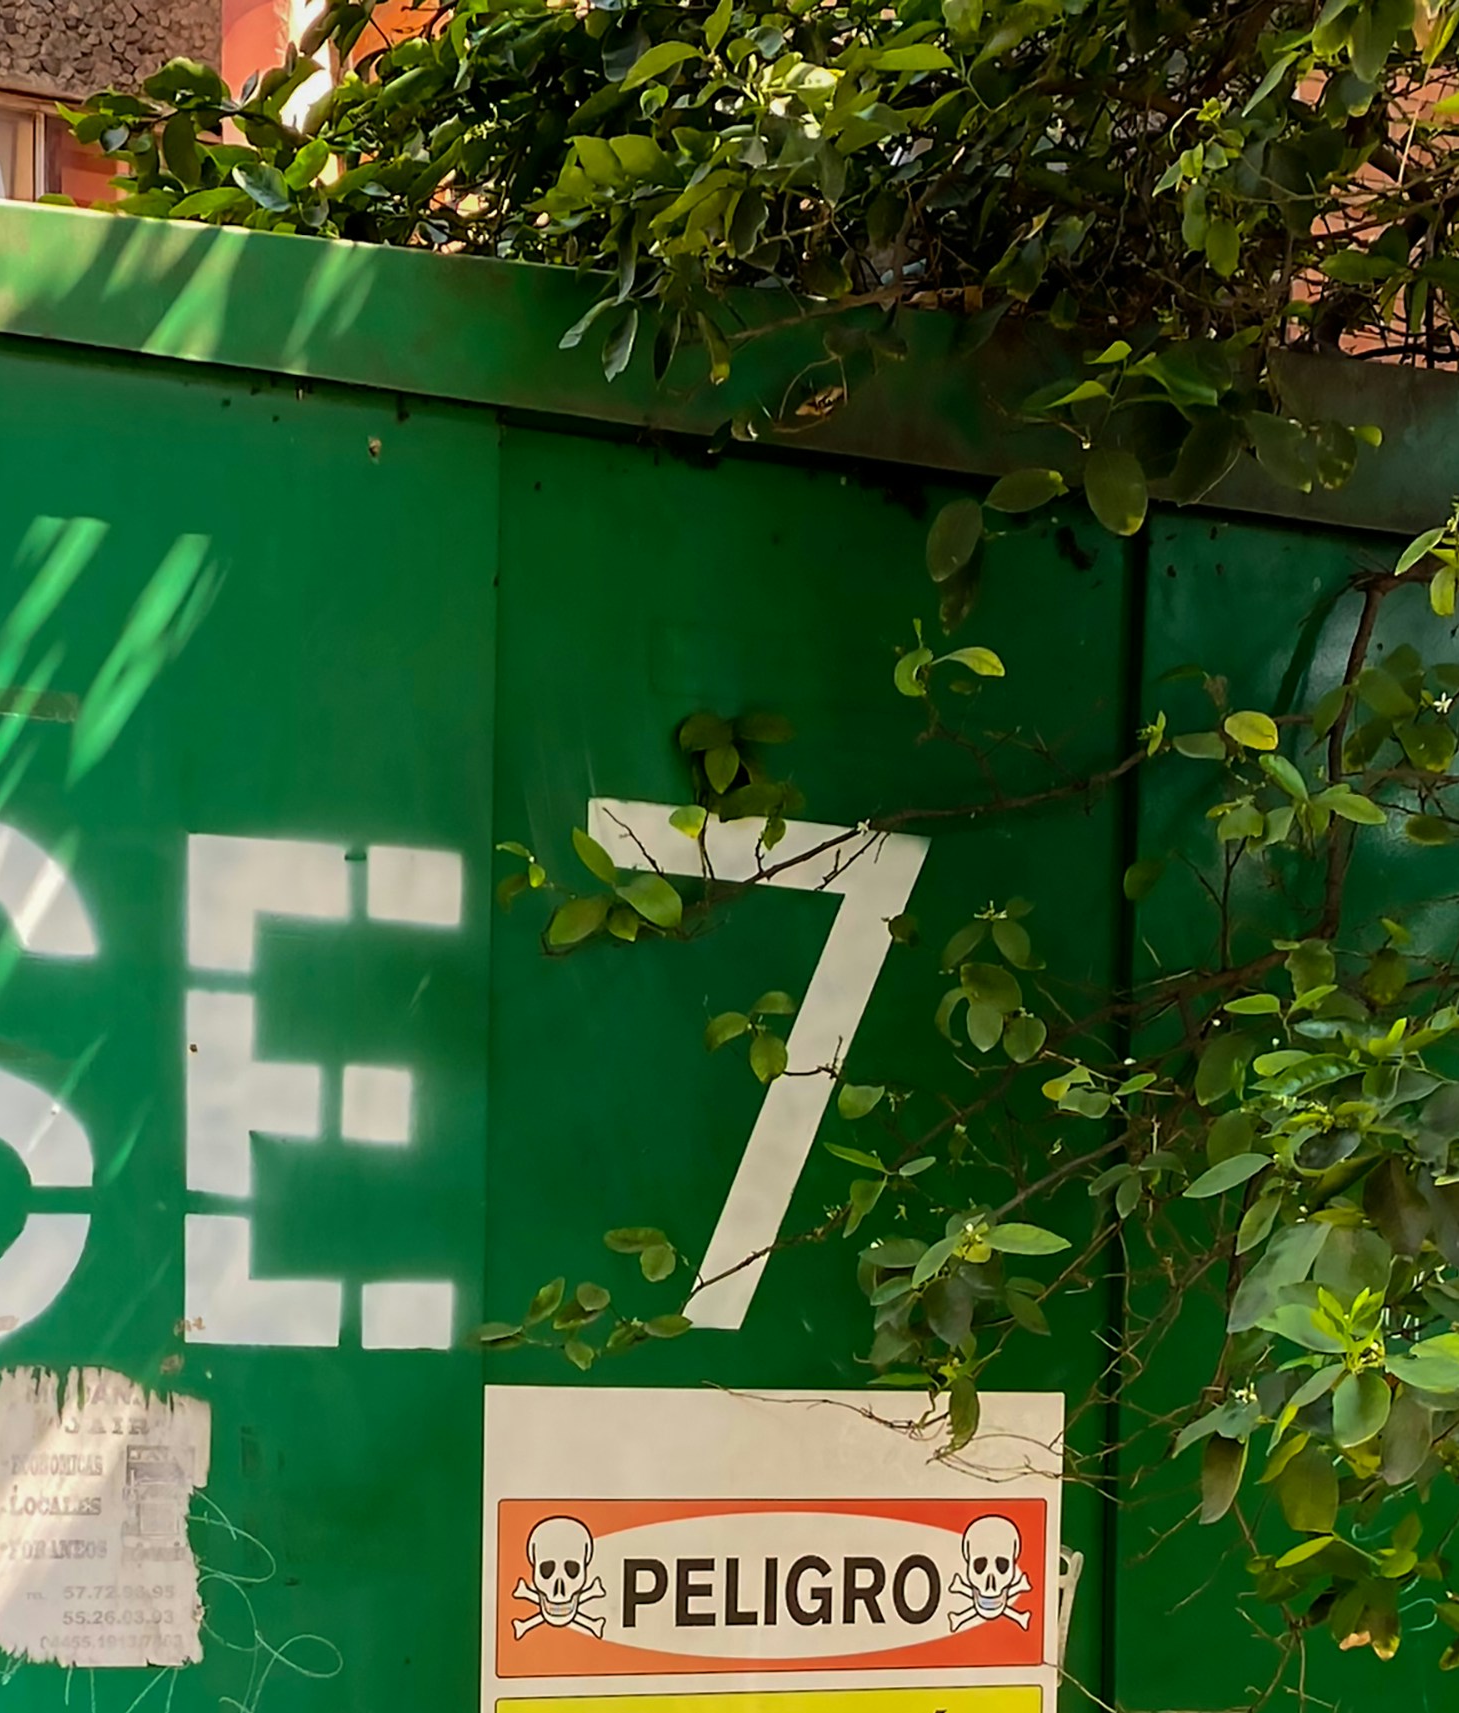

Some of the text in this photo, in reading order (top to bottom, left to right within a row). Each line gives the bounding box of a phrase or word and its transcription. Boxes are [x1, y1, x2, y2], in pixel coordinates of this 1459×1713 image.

[588, 797, 931, 1330] 7
[8, 1496, 102, 1516] LOCALES
[622, 1553, 942, 1629] PELIGRO
